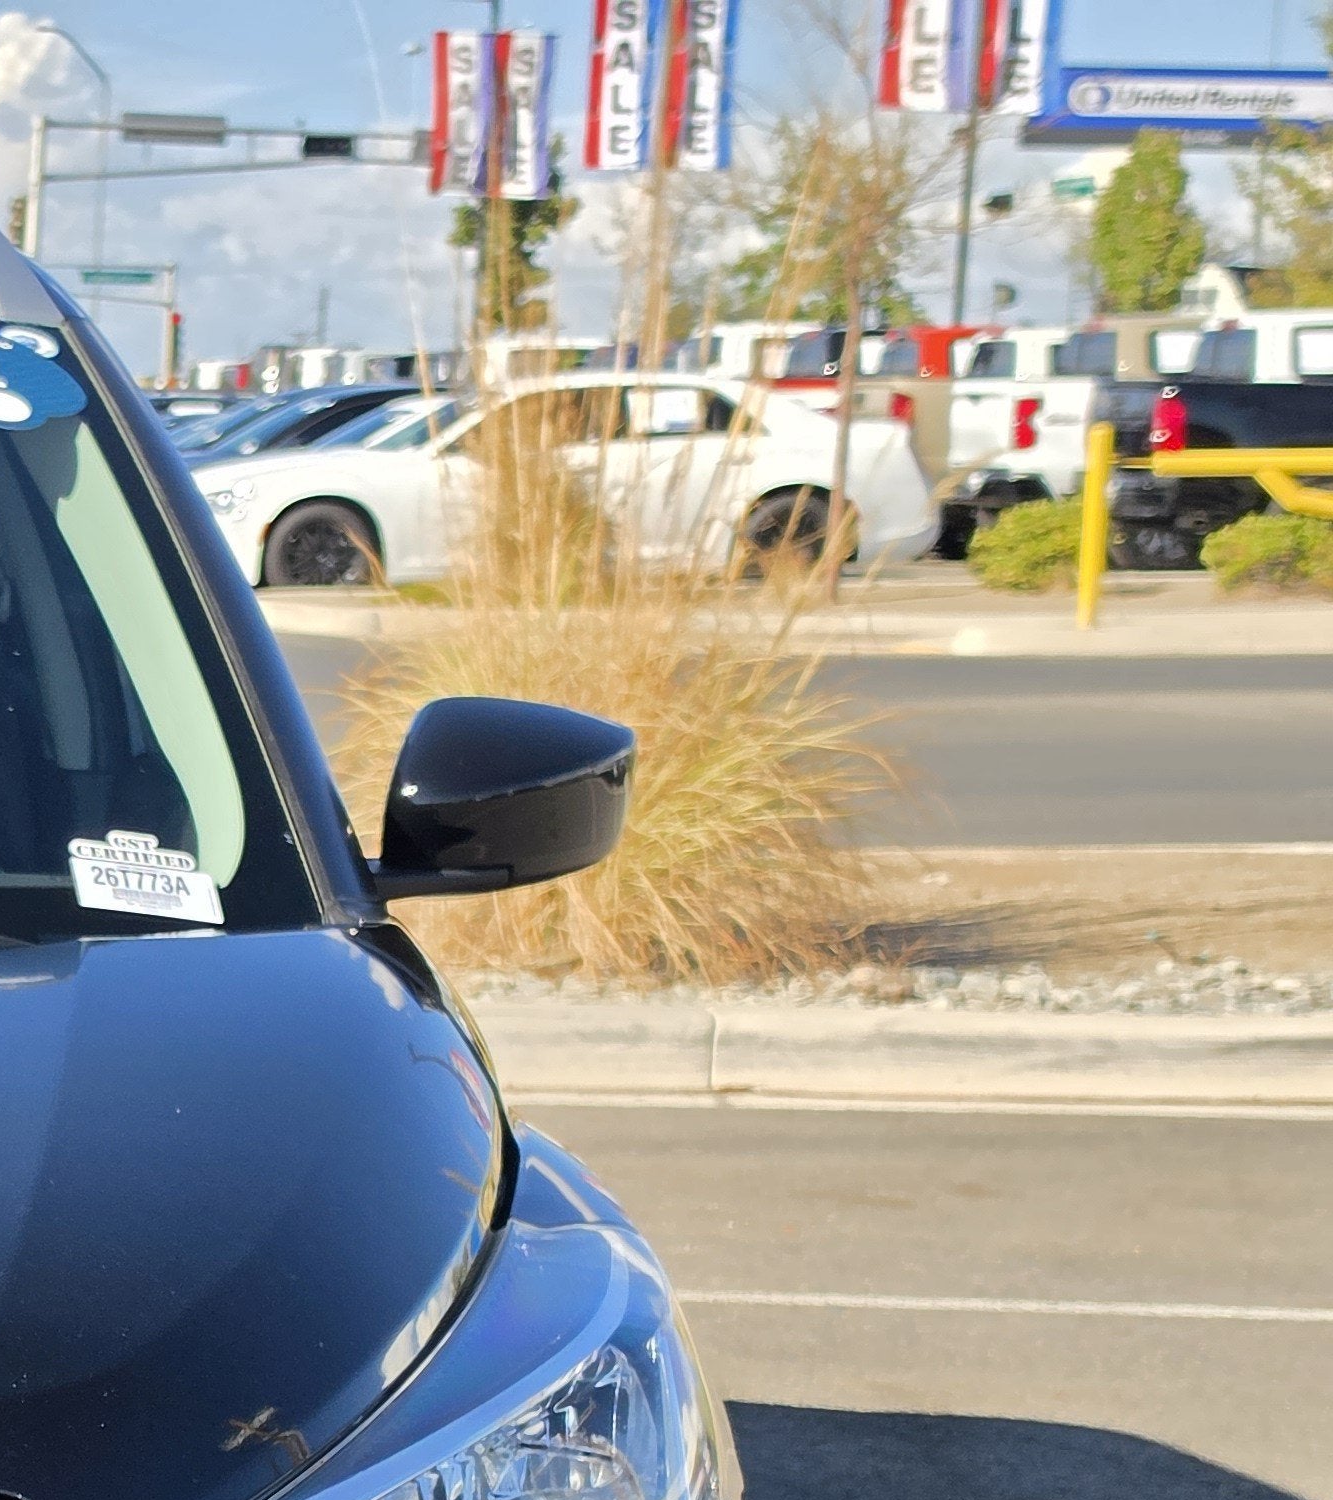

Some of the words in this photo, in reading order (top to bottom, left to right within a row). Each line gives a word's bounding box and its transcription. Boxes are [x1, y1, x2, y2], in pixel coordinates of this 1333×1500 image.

[450, 46, 474, 185] SALE
[608, 0, 638, 154] SALE
[689, 0, 717, 154] SALE
[76, 845, 191, 870] CERTIFIED
[91, 865, 191, 896] 26T773A
[113, 837, 153, 851] GST
